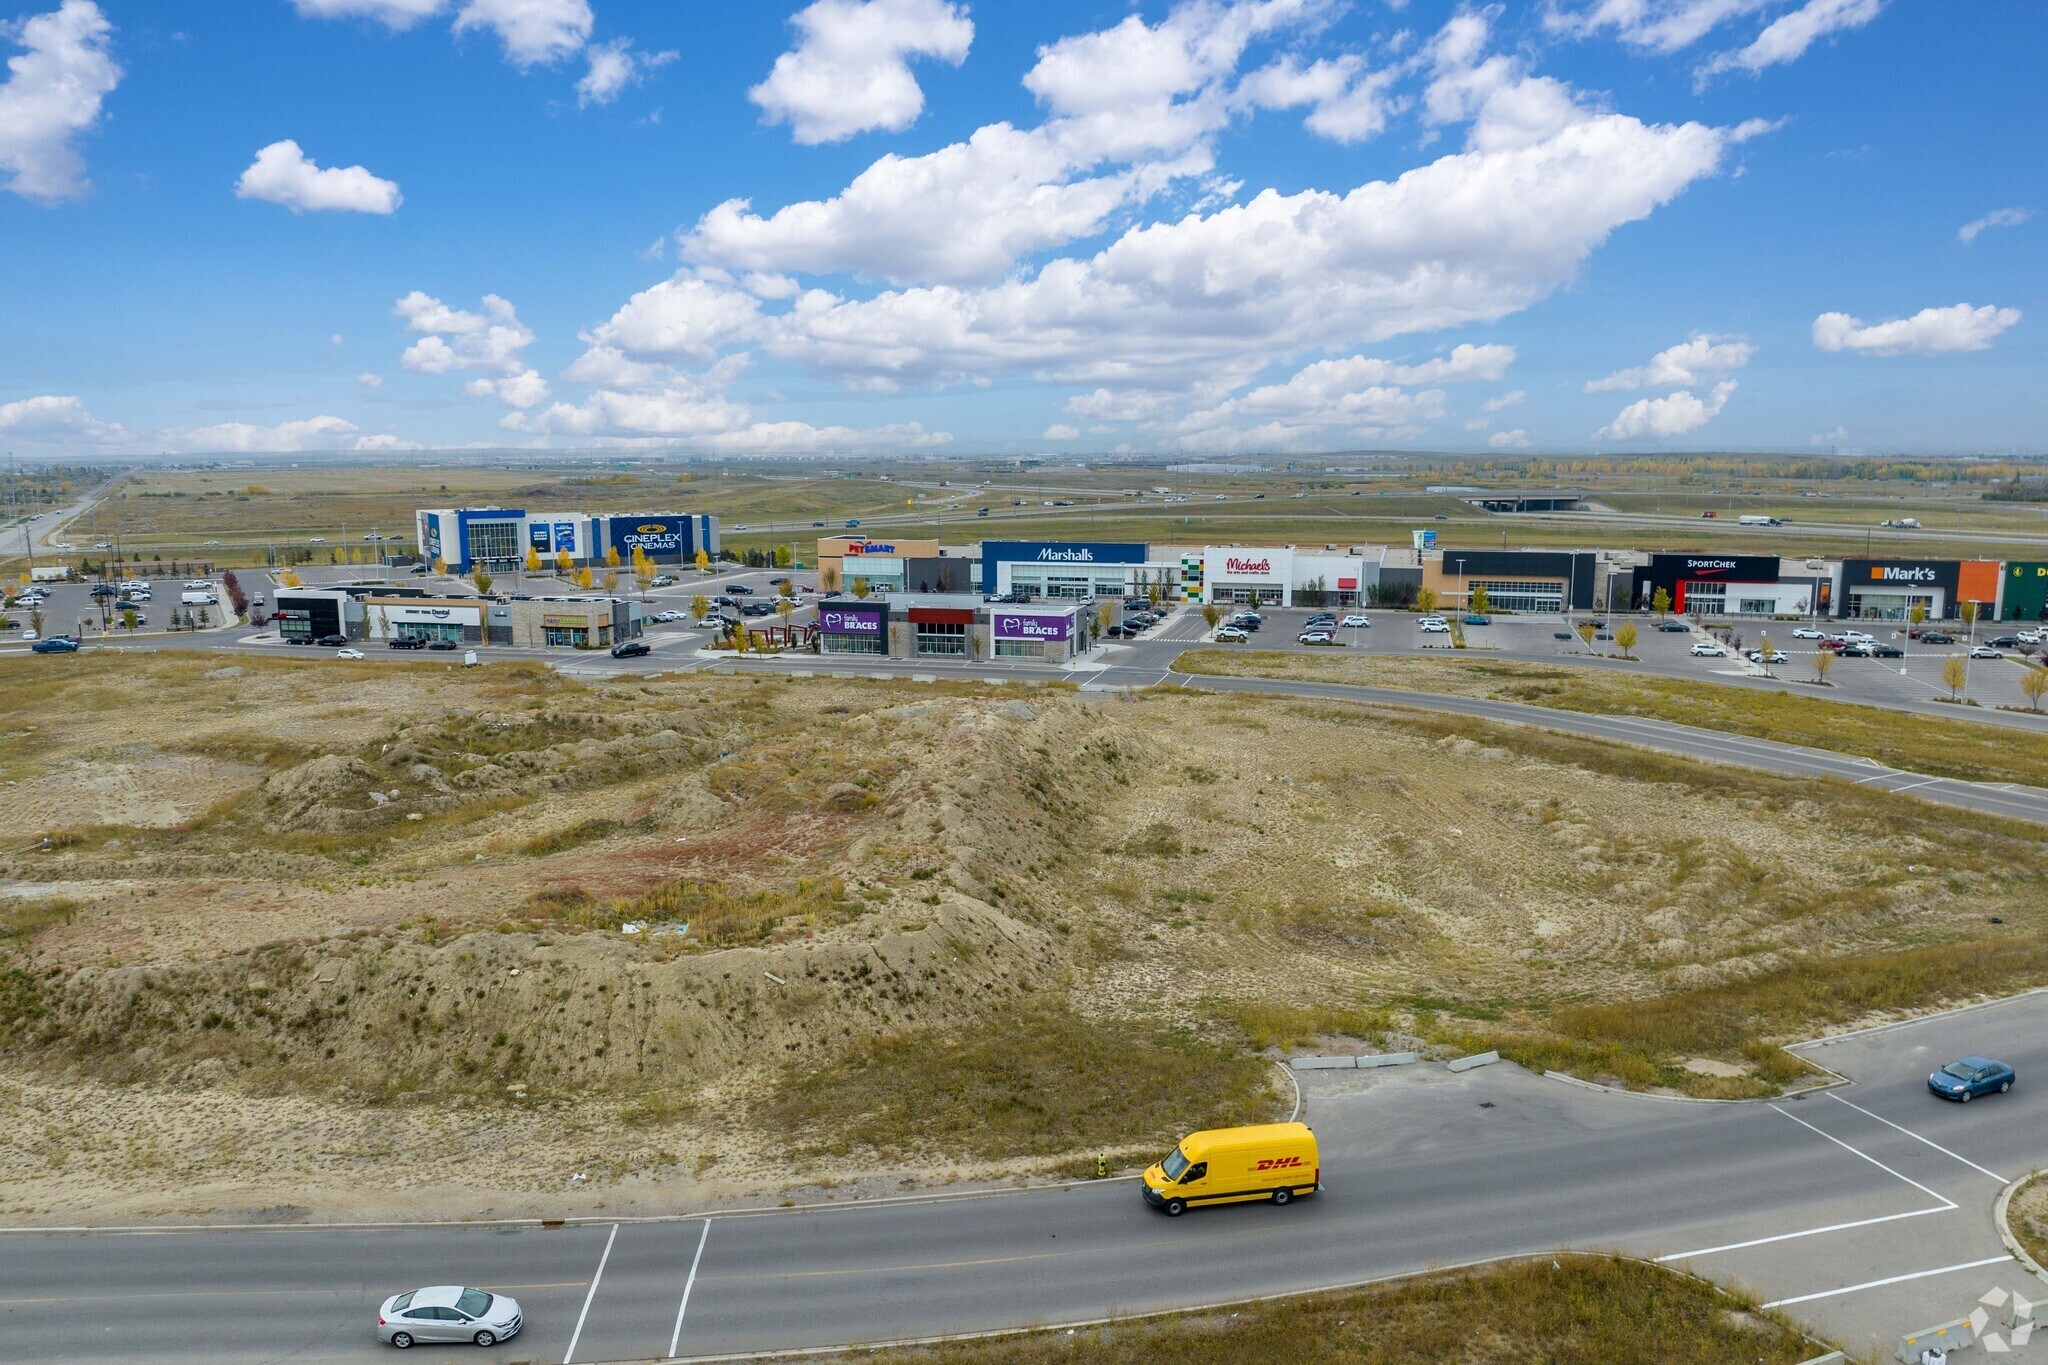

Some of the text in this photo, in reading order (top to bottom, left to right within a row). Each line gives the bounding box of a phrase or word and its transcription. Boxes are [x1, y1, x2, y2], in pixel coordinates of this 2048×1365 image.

[624, 533, 681, 543] CINEPLEX
[630, 542, 675, 550] CINEMAS
[1037, 548, 1093, 561] Marshalls
[1883, 566, 1936, 580] Mark's
[2037, 567, 2048, 577] D
[843, 613, 858, 623] family
[1022, 618, 1038, 628] family
[844, 621, 878, 630] BRACES
[1023, 627, 1058, 635] BRACES
[1257, 1156, 1303, 1171] DHL
